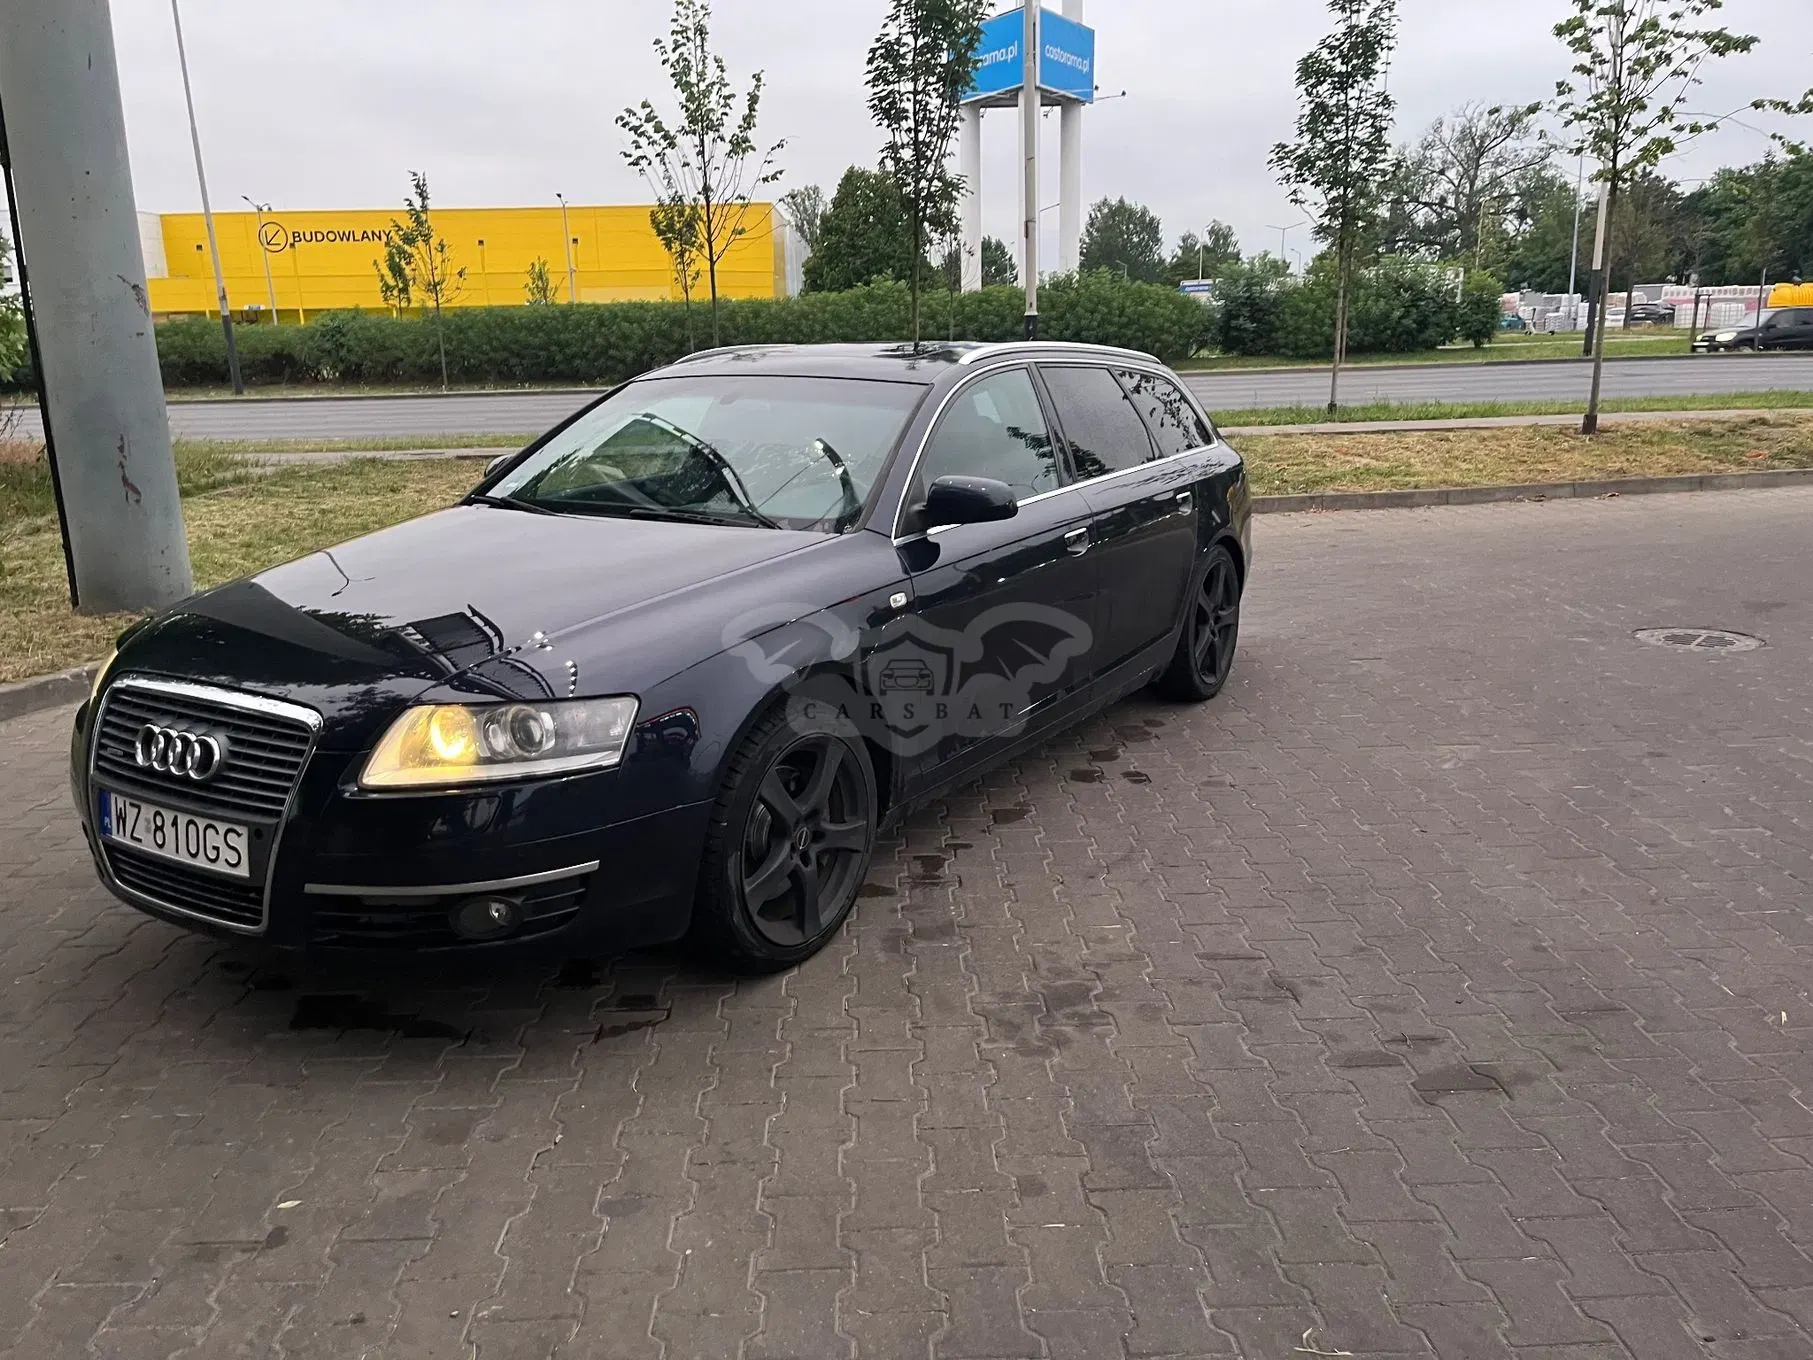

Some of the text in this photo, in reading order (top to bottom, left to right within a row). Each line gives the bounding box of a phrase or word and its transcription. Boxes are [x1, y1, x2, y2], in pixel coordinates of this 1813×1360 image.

[1045, 43, 1090, 75] castorama.pl
[291, 229, 392, 243] BUDOWLANY
[114, 796, 244, 868] WZ 810GS
